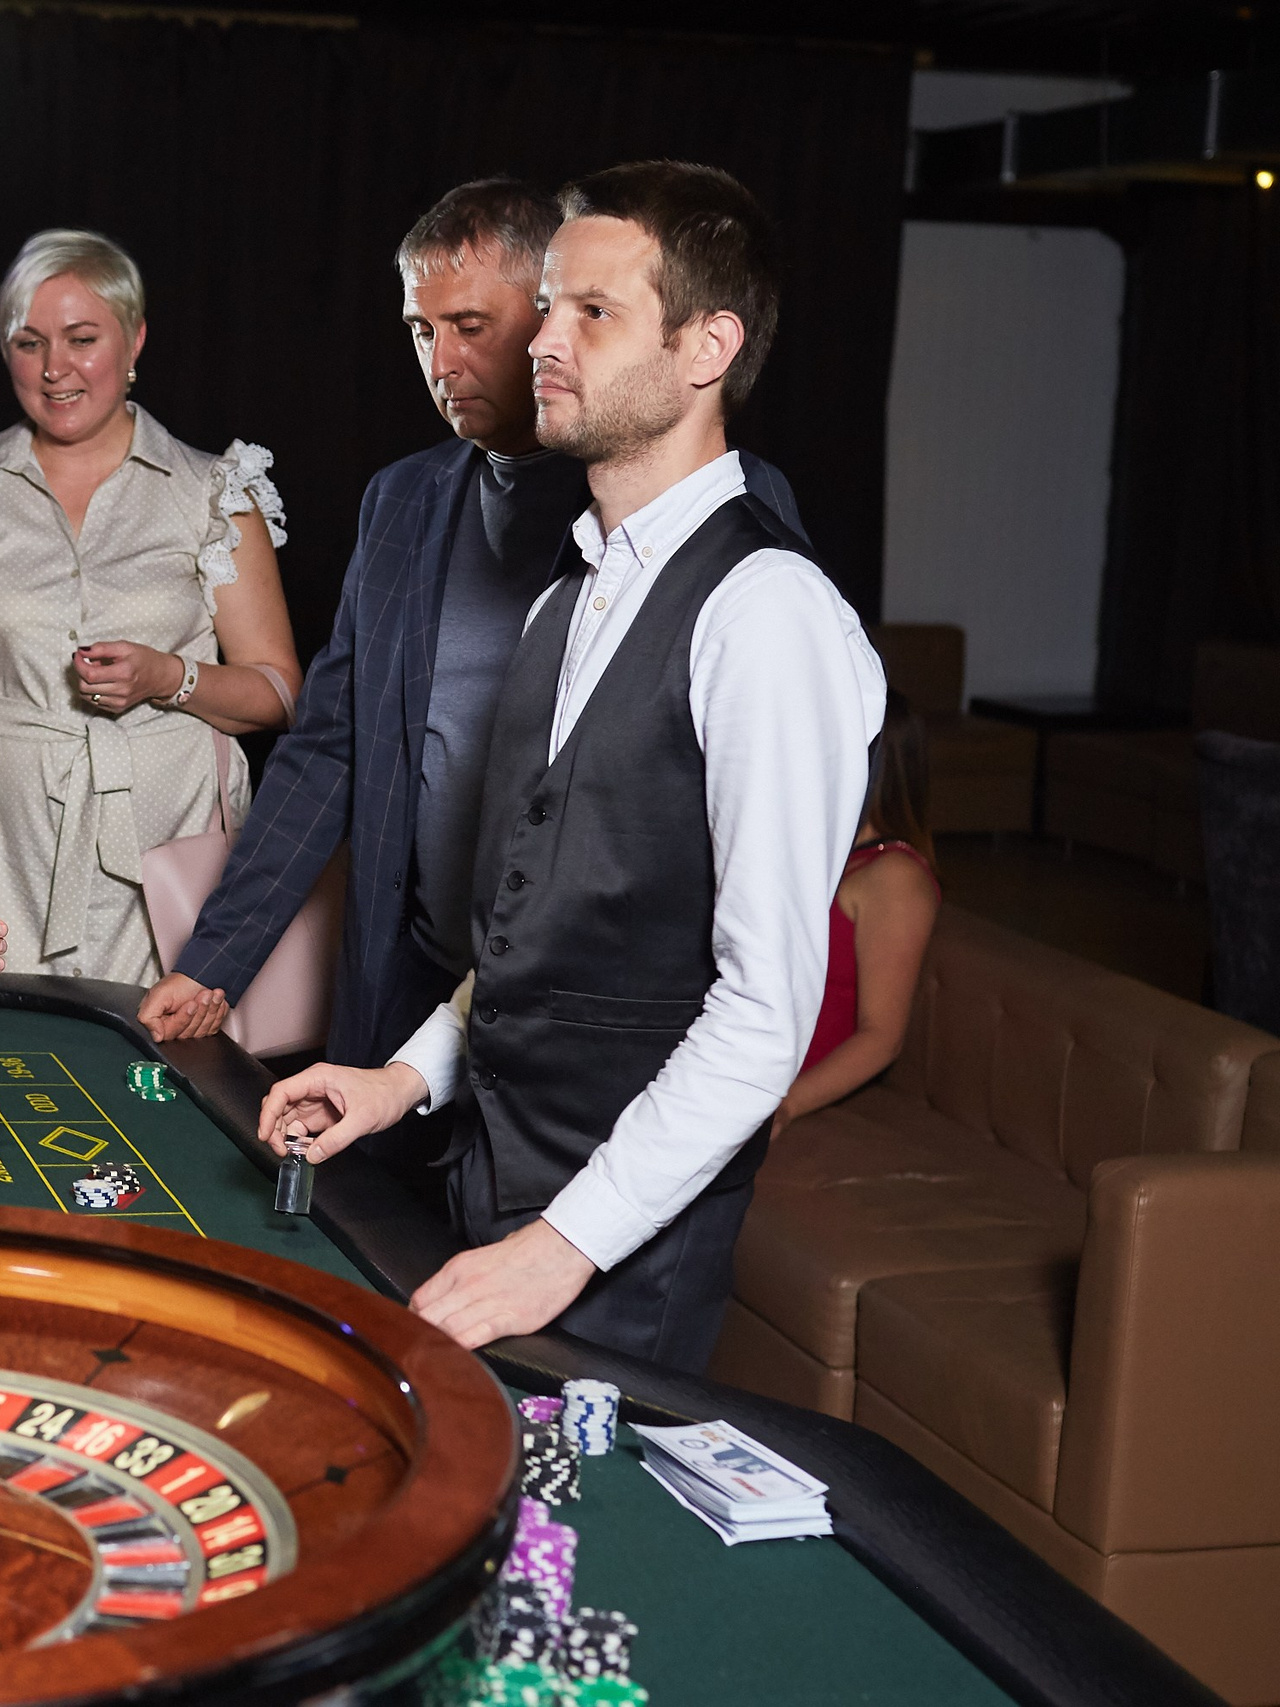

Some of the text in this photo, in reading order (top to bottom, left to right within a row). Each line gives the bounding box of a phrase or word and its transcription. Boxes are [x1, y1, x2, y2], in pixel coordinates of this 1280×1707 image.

[24, 1093, 59, 1113] ODD
[15, 1402, 75, 1442] 24
[73, 1420, 126, 1457] 16
[114, 1437, 174, 1477] 33
[160, 1465, 207, 1495] 1
